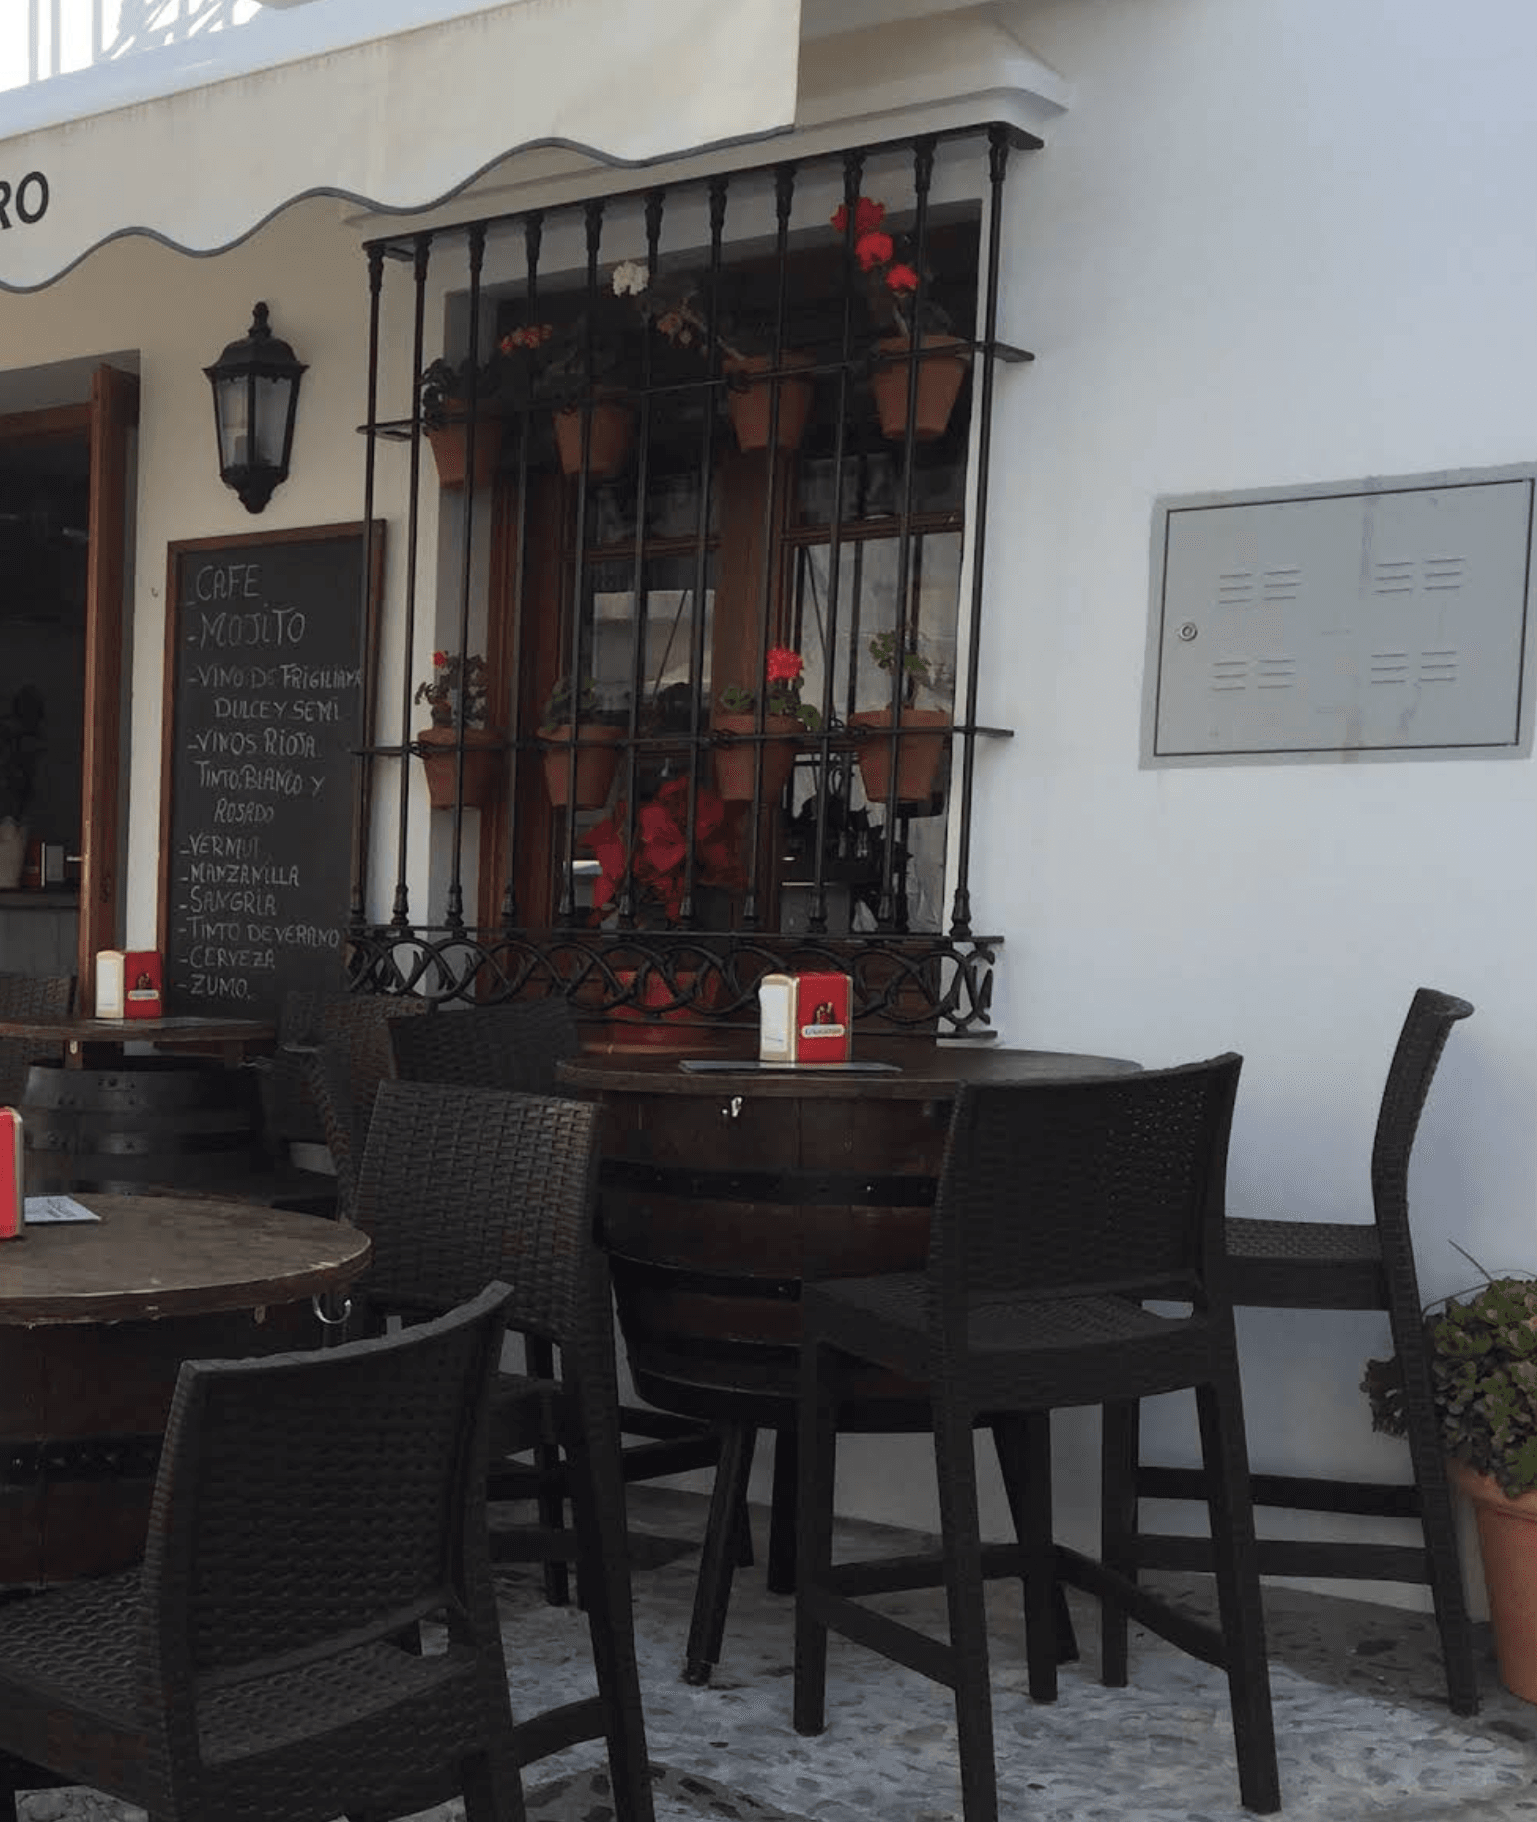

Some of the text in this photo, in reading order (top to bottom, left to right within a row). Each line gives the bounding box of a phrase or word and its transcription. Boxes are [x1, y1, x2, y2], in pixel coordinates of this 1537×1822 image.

[214, 697, 271, 719] DULCE
[272, 700, 287, 719] Y
[240, 763, 303, 796] BLANCO
[309, 775, 326, 798] Y
[213, 797, 275, 825] ROSADO
[247, 922, 273, 943] DE
[273, 924, 340, 948] VERANO
